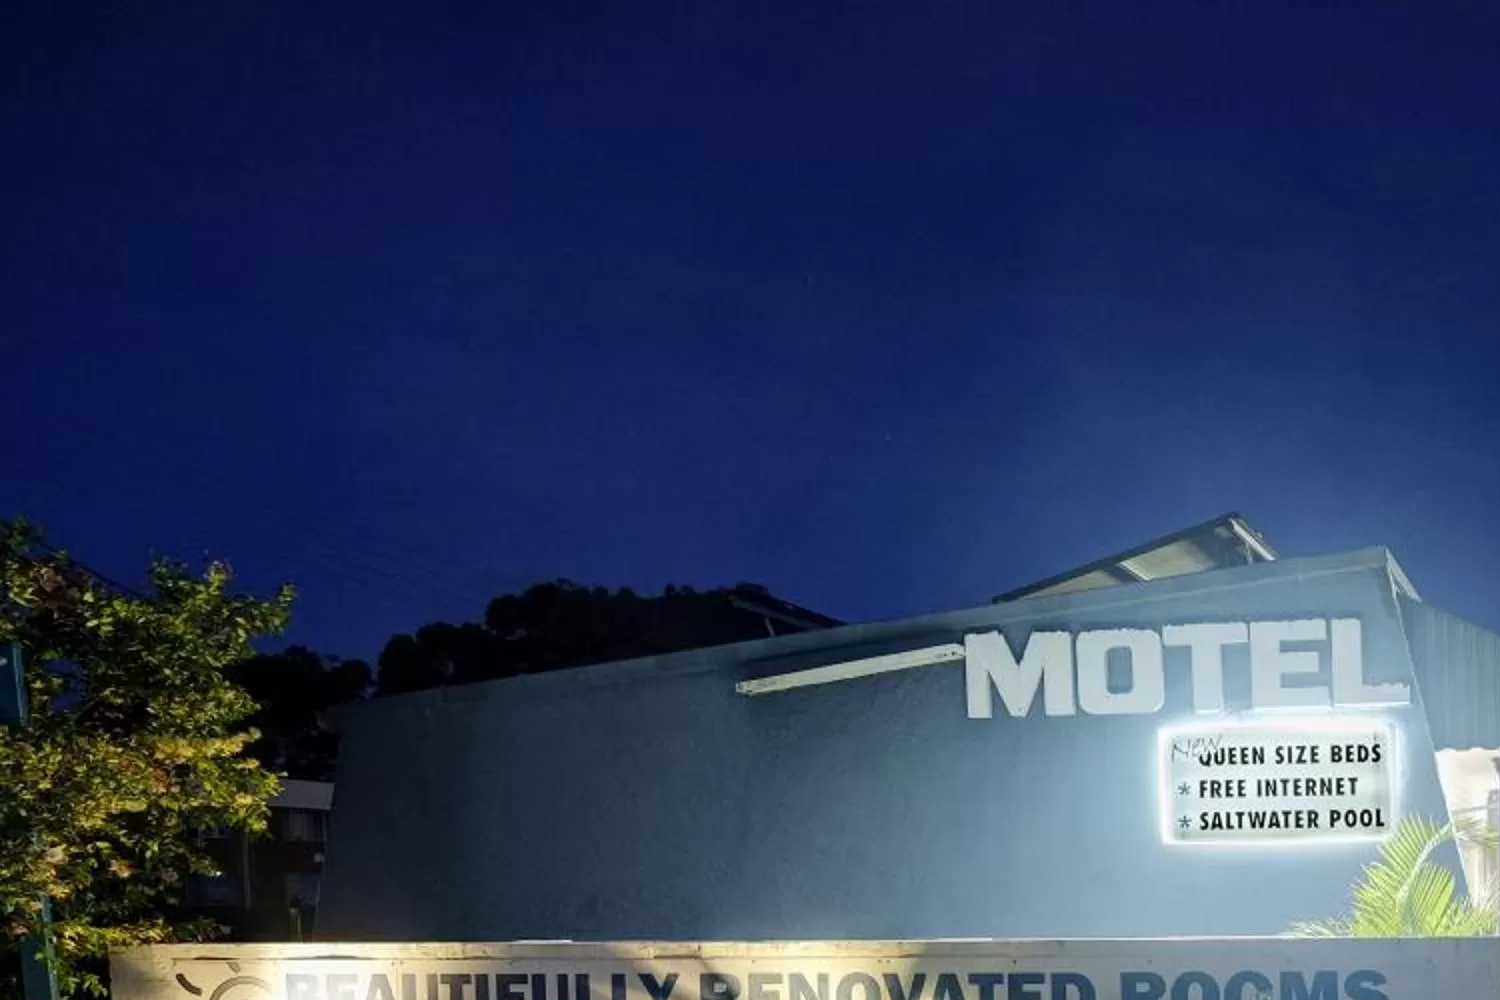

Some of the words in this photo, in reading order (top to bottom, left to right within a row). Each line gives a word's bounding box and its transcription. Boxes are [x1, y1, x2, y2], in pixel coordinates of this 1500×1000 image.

[963, 617, 1411, 719] MOTEL
[1199, 746, 1265, 766] QUEEN
[1275, 744, 1320, 765] SIZE
[1331, 743, 1382, 763] BEDS
[1199, 779, 1247, 799] FREE
[1256, 777, 1359, 798] INTERNET
[1199, 809, 1320, 830] SALTWATER
[1330, 808, 1385, 829] POOL
